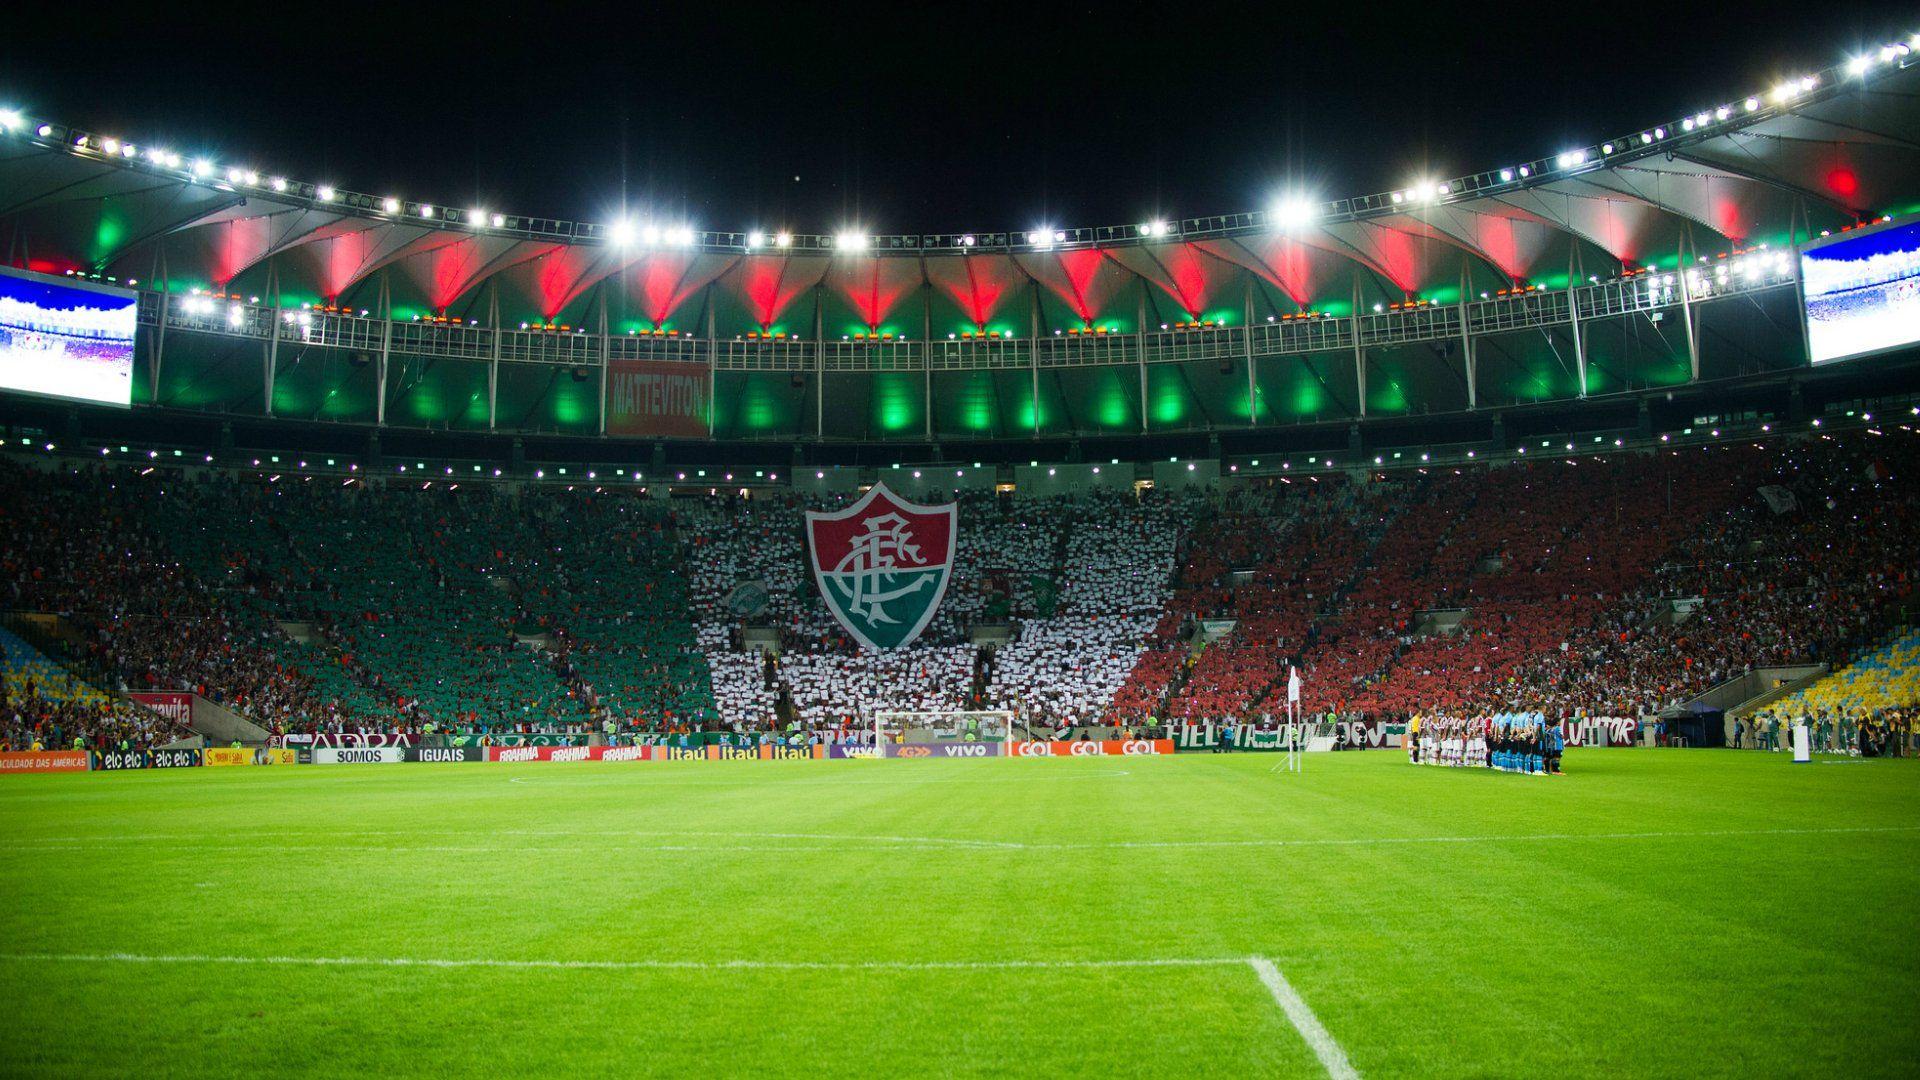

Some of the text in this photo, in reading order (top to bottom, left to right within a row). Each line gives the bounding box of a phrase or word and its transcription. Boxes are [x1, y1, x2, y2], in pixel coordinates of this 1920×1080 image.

[499, 746, 642, 762] BRAHMA BRAHMA BRAHMA
[670, 746, 810, 760] Itaú Itaú Itaú
[1018, 740, 1160, 756] GOL GOL GOL
[337, 750, 382, 763] SOMOS
[419, 749, 465, 762] IGUAIS
[36, 758, 50, 768] DAS
